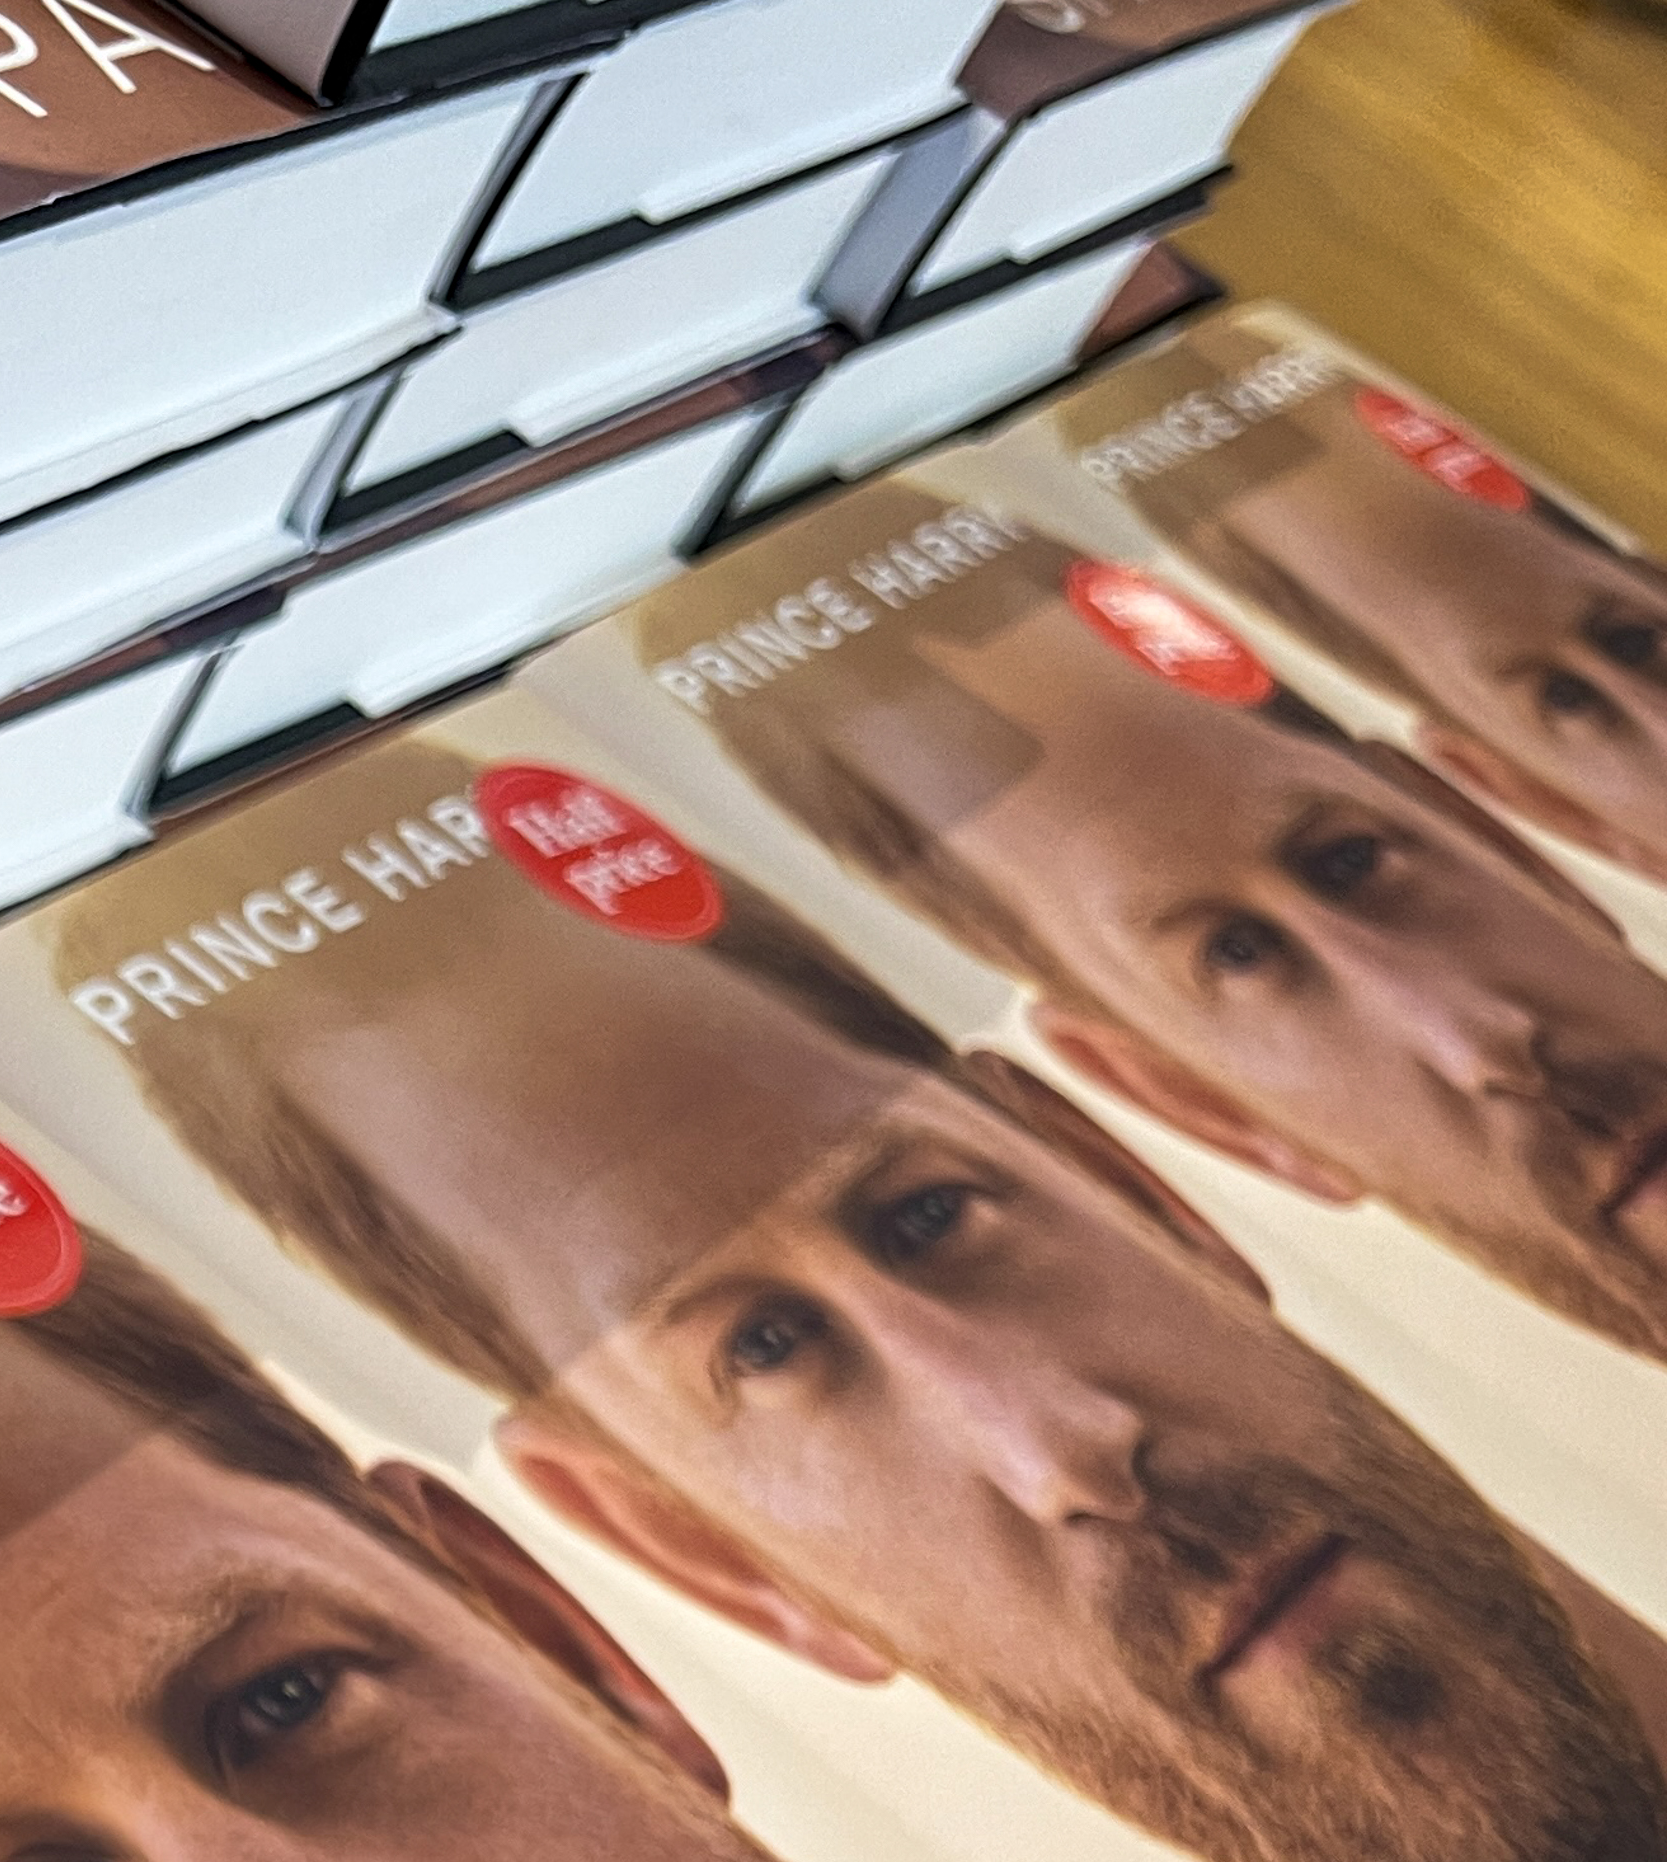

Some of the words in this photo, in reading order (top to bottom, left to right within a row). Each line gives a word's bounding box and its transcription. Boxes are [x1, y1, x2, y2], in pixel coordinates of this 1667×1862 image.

[655, 575, 875, 716] PRINCE
[848, 503, 1031, 609] HARRY
[71, 866, 365, 1047] PRINCE
[340, 784, 490, 903] HAR
